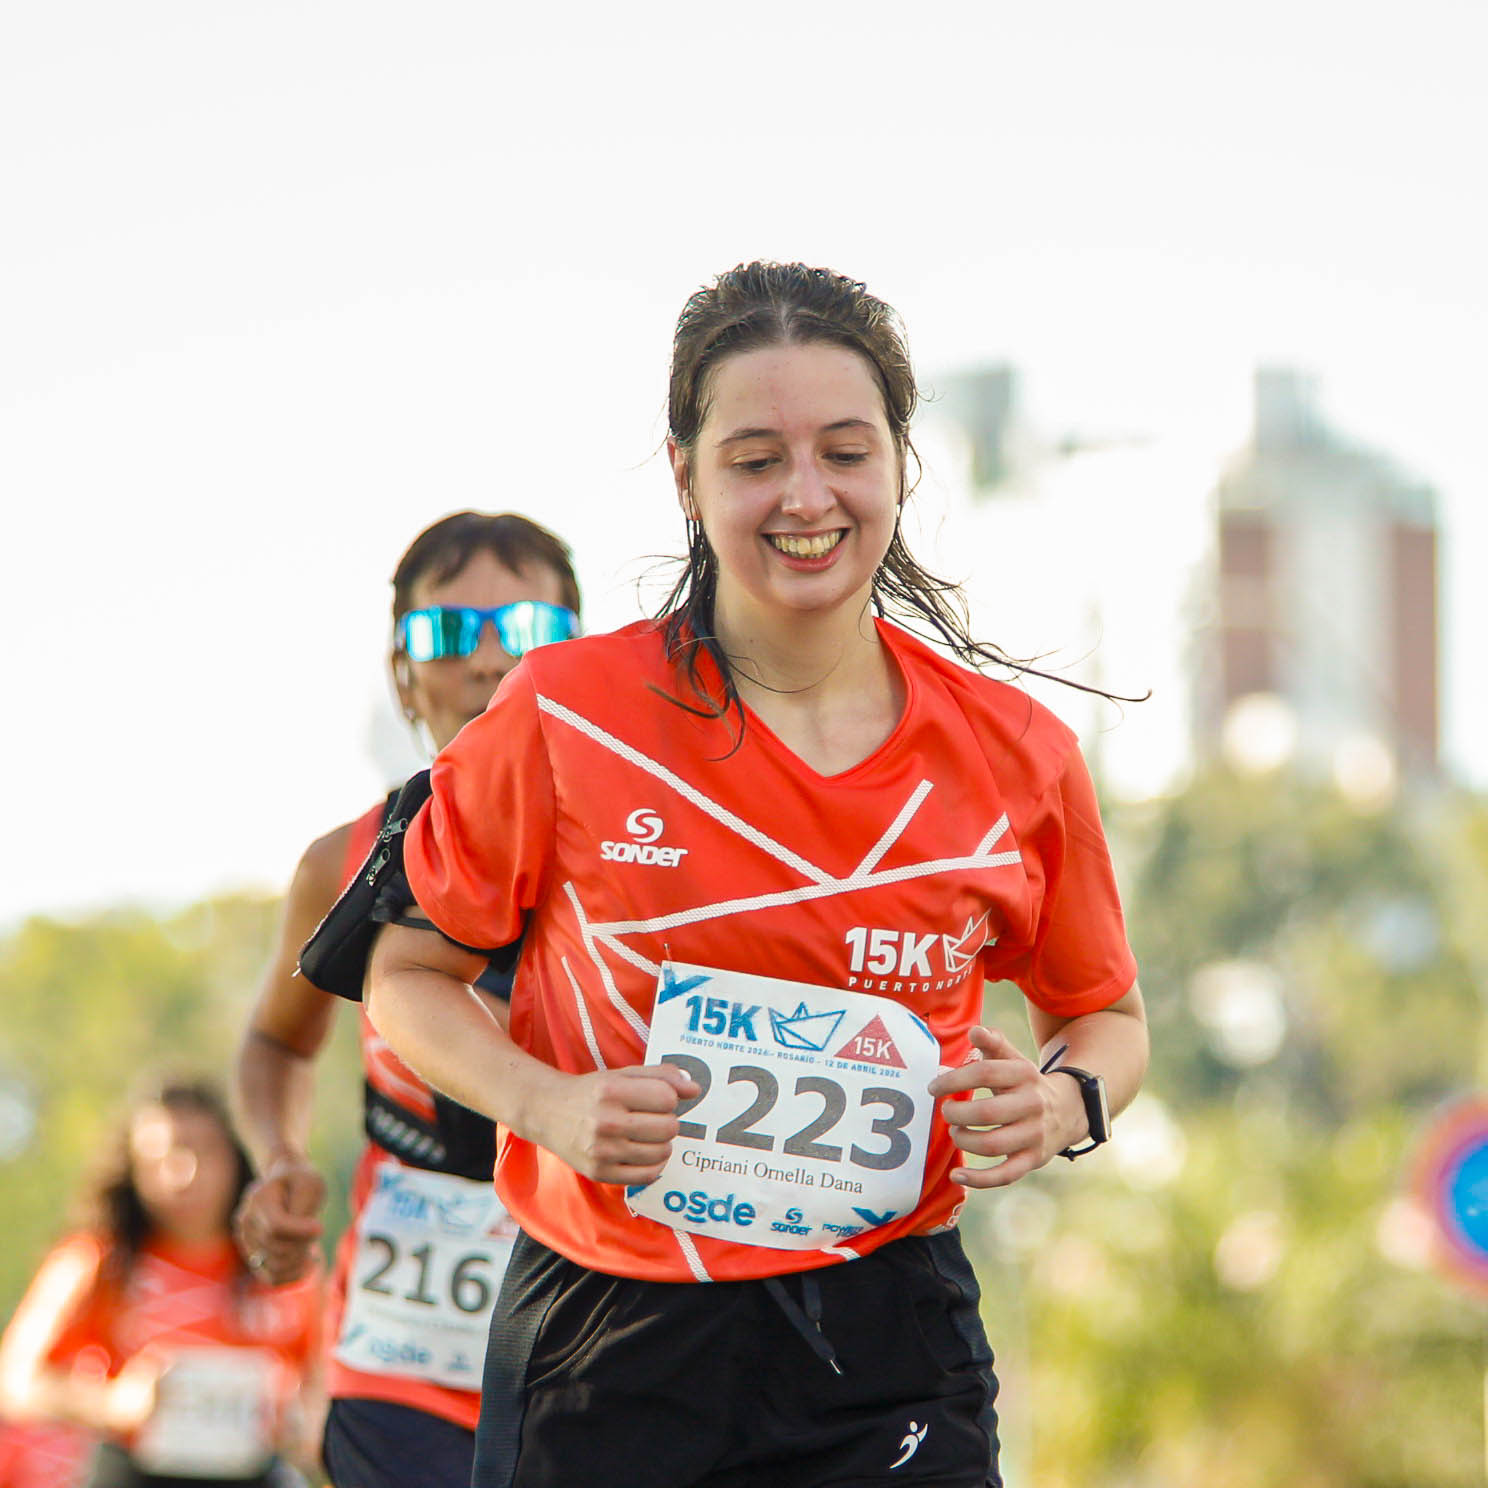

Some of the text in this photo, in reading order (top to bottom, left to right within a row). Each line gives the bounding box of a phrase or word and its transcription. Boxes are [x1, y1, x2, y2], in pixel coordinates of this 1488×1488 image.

[845, 926, 939, 977] 15K
[848, 976, 930, 992] PUERTO
[686, 995, 762, 1041] 15K
[680, 1034, 714, 1047] PUERTO
[717, 1042, 744, 1052] NORTE
[777, 1051, 815, 1064] ROSARIO
[852, 1064, 876, 1074] ABRIL
[880, 1069, 900, 1078] 2026
[854, 1036, 891, 1060] 15K
[661, 1053, 915, 1171] 2223
[681, 1150, 863, 1194] Cipriani Ornella Dana
[664, 1190, 756, 1226] osde
